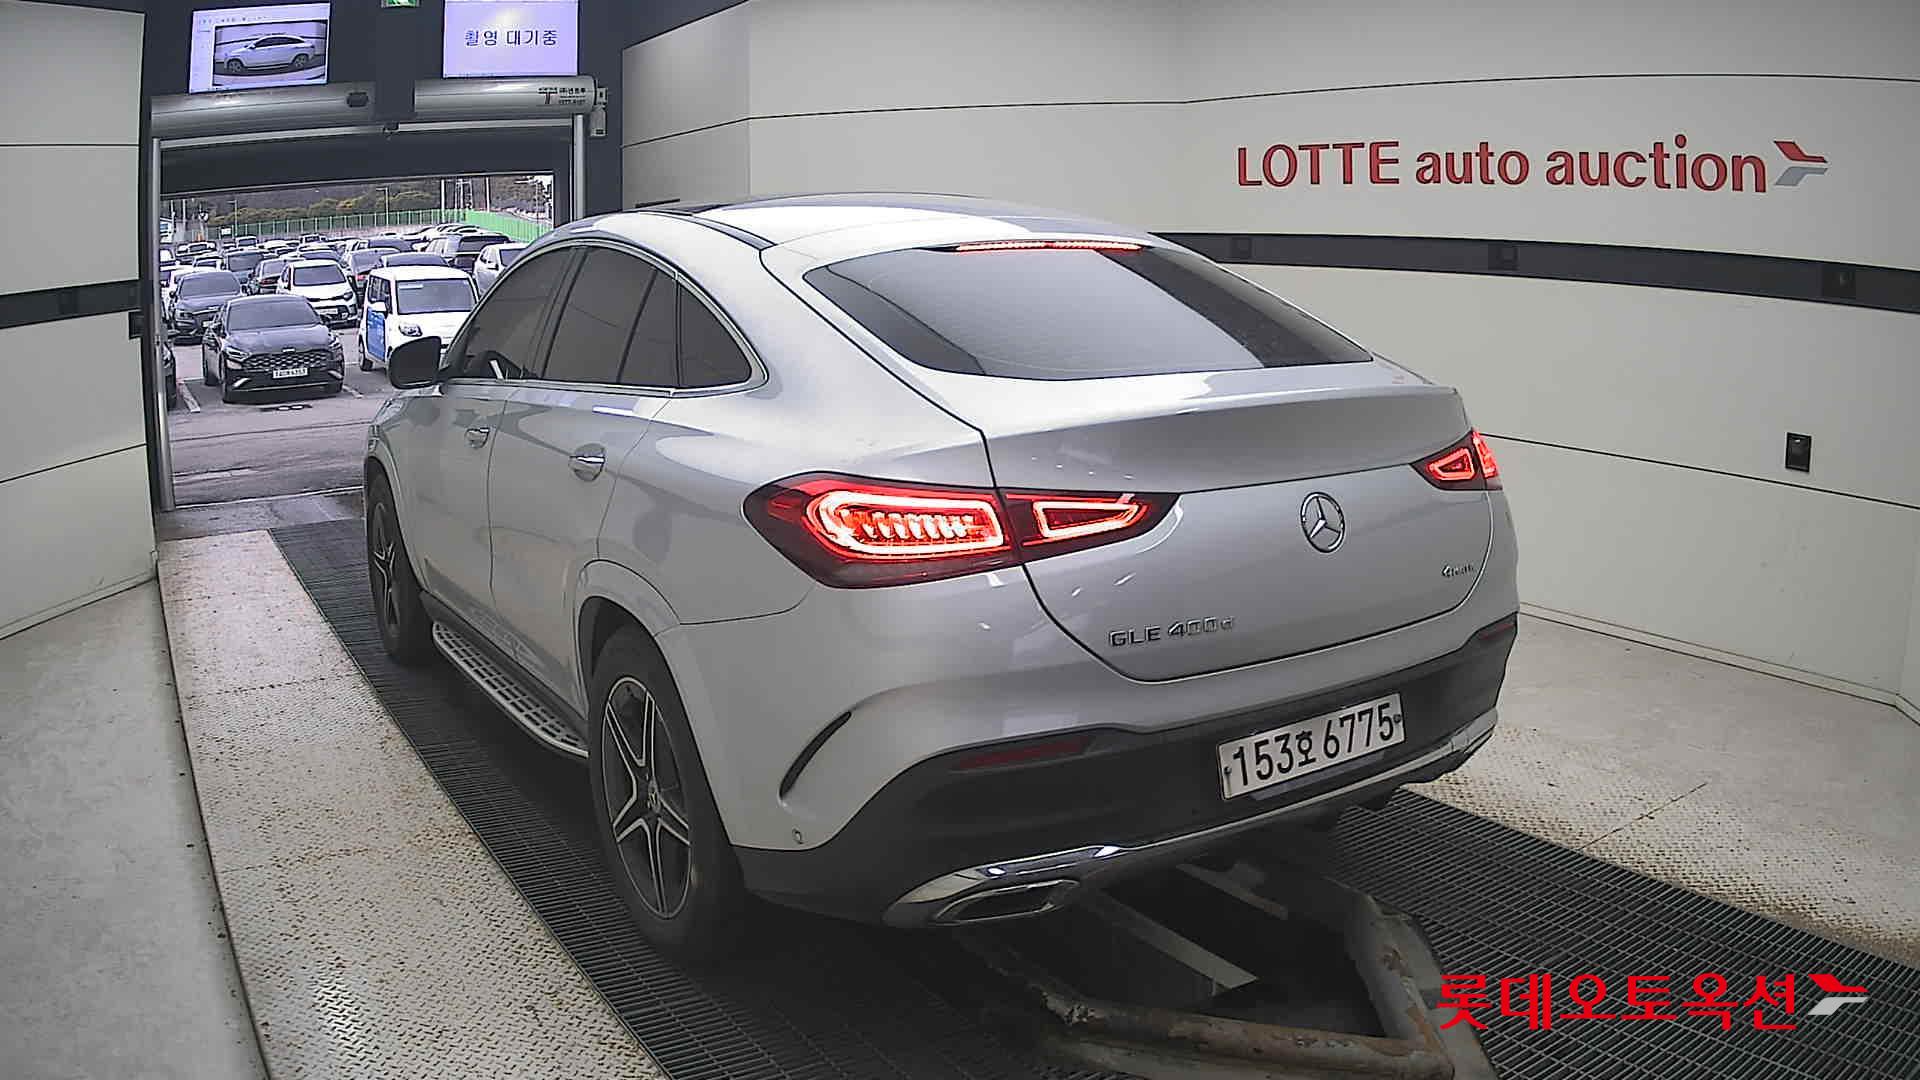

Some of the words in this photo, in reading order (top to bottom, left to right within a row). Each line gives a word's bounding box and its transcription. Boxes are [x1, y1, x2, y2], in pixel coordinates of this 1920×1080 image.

[506, 29, 558, 47] 대기중
[1237, 141, 1400, 187] LOTTE
[1415, 141, 1530, 185] auto
[1546, 134, 1767, 193] auction
[1109, 624, 1161, 647] GLE
[1323, 702, 1394, 759] 6775
